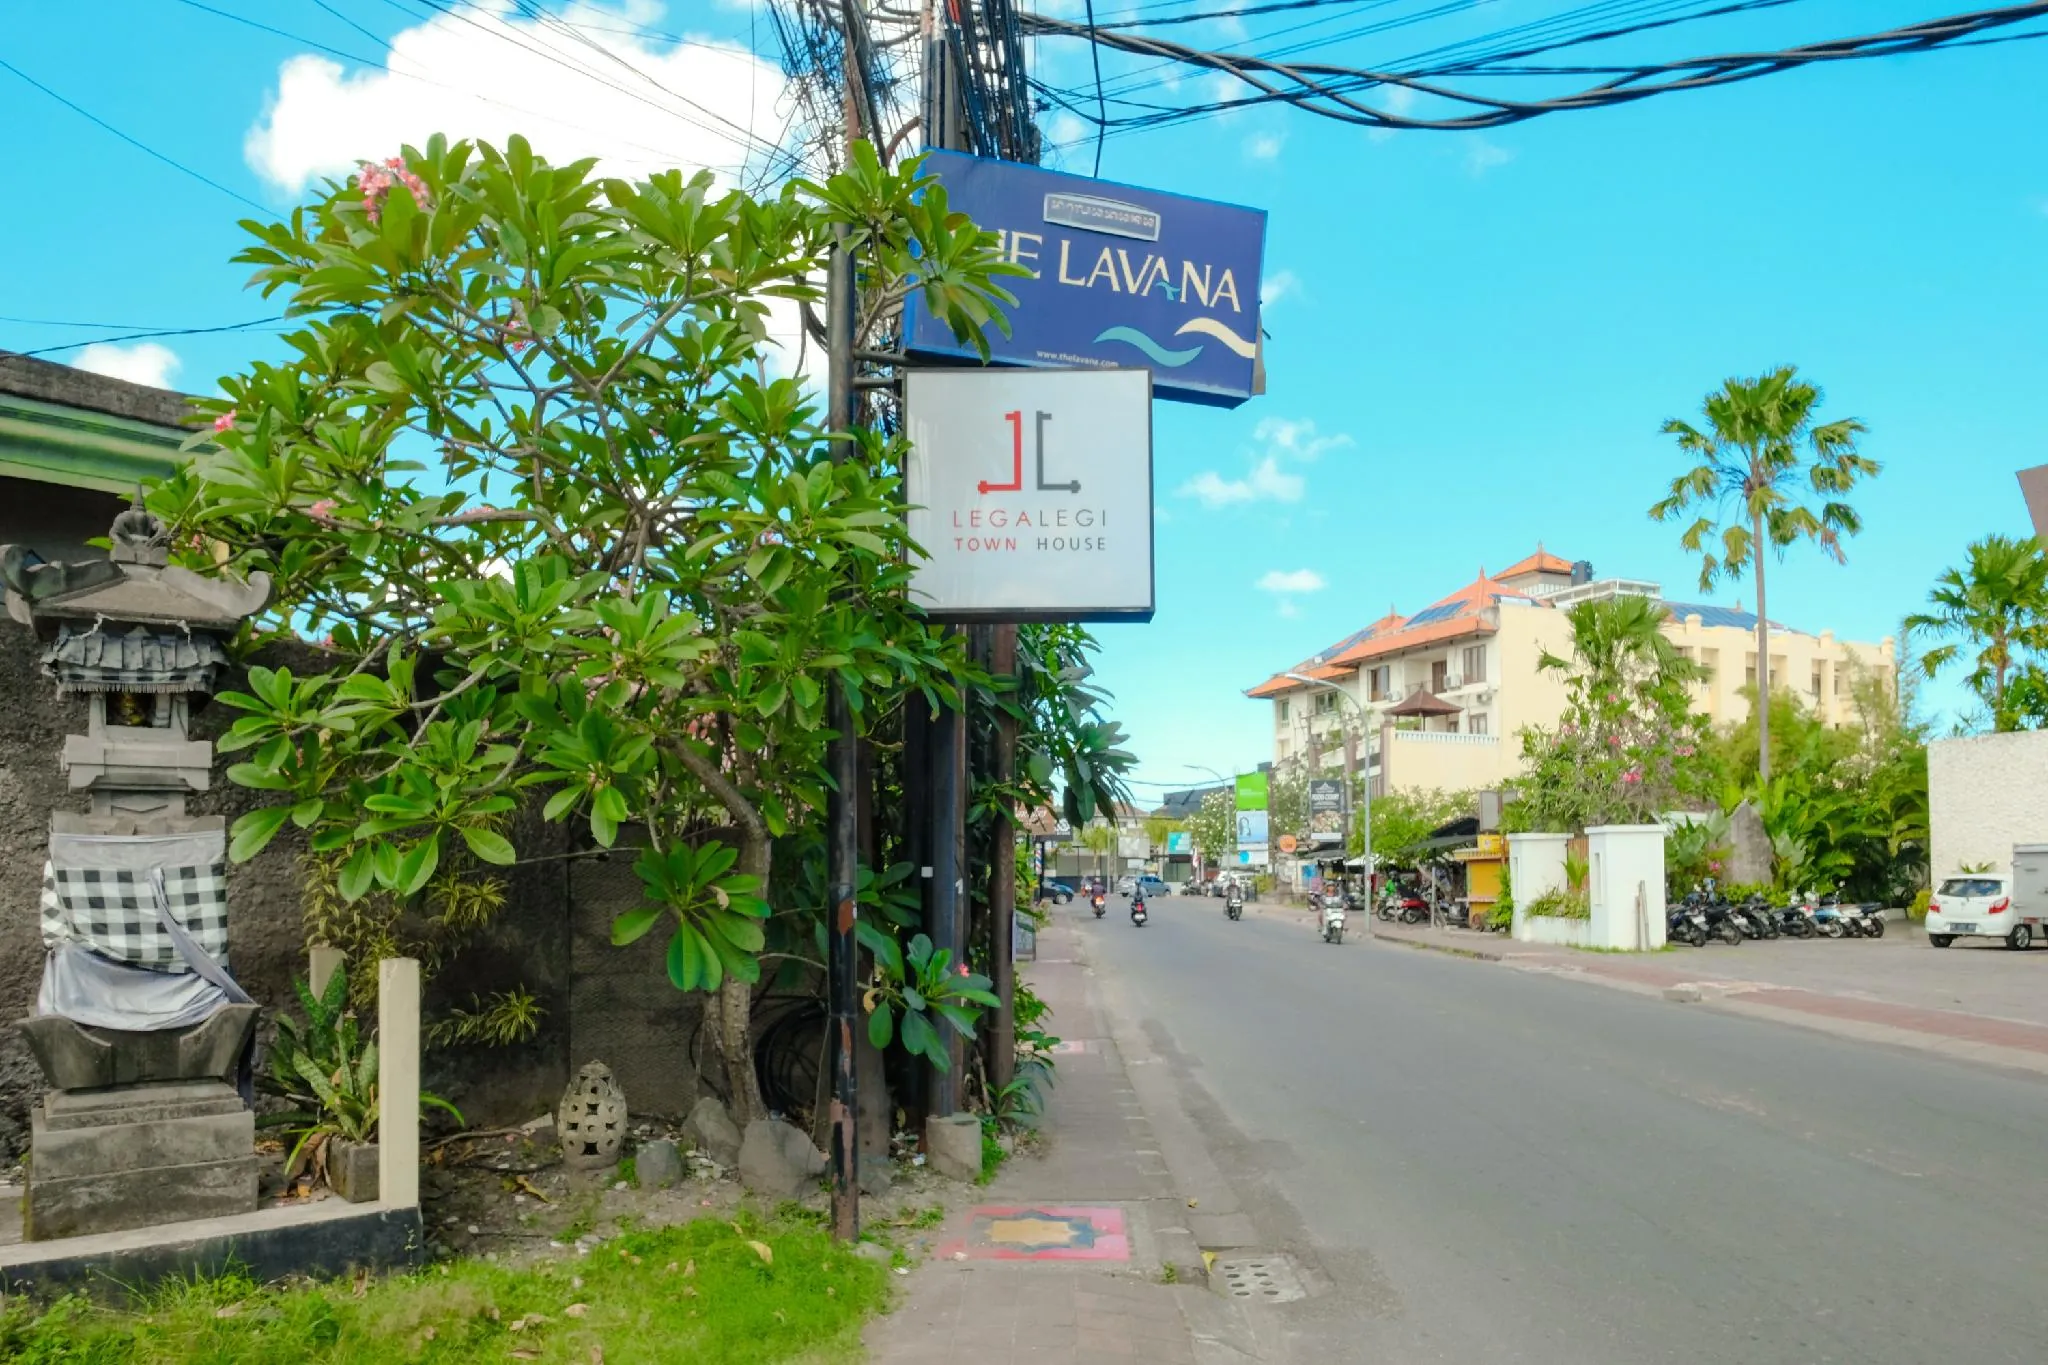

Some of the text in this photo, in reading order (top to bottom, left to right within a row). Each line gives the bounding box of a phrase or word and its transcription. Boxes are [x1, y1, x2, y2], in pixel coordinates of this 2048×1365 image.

[1058, 239, 1241, 312] LAVANA
[953, 509, 1106, 529] LEGALEGI
[954, 537, 1106, 552] TOWN HOUSE
